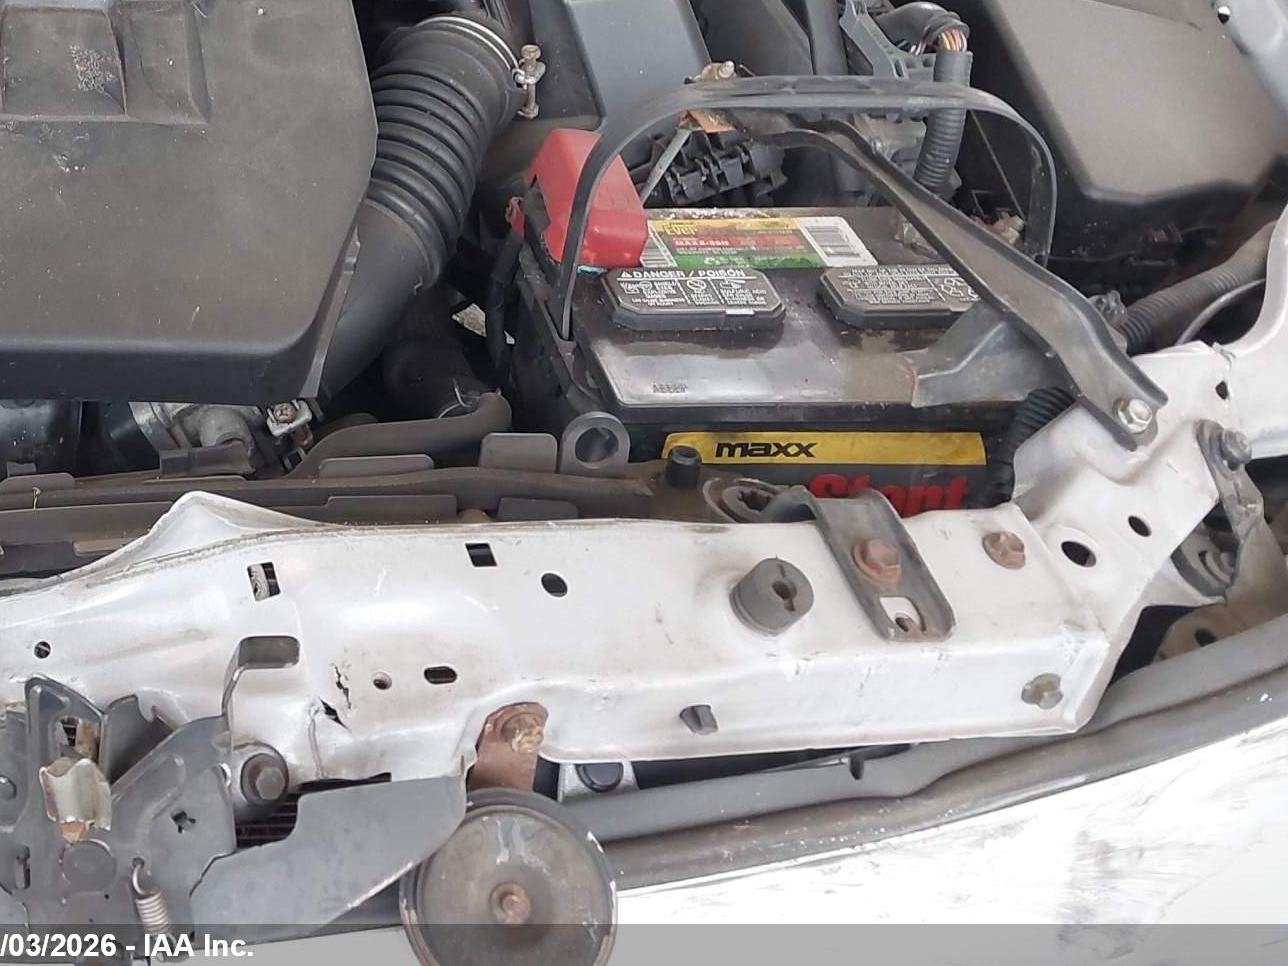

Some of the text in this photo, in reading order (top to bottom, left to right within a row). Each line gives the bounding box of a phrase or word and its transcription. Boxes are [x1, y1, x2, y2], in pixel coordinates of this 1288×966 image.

[632, 270, 685, 278] DANGER
[699, 269, 746, 277] POISON
[715, 441, 818, 458] maxx
